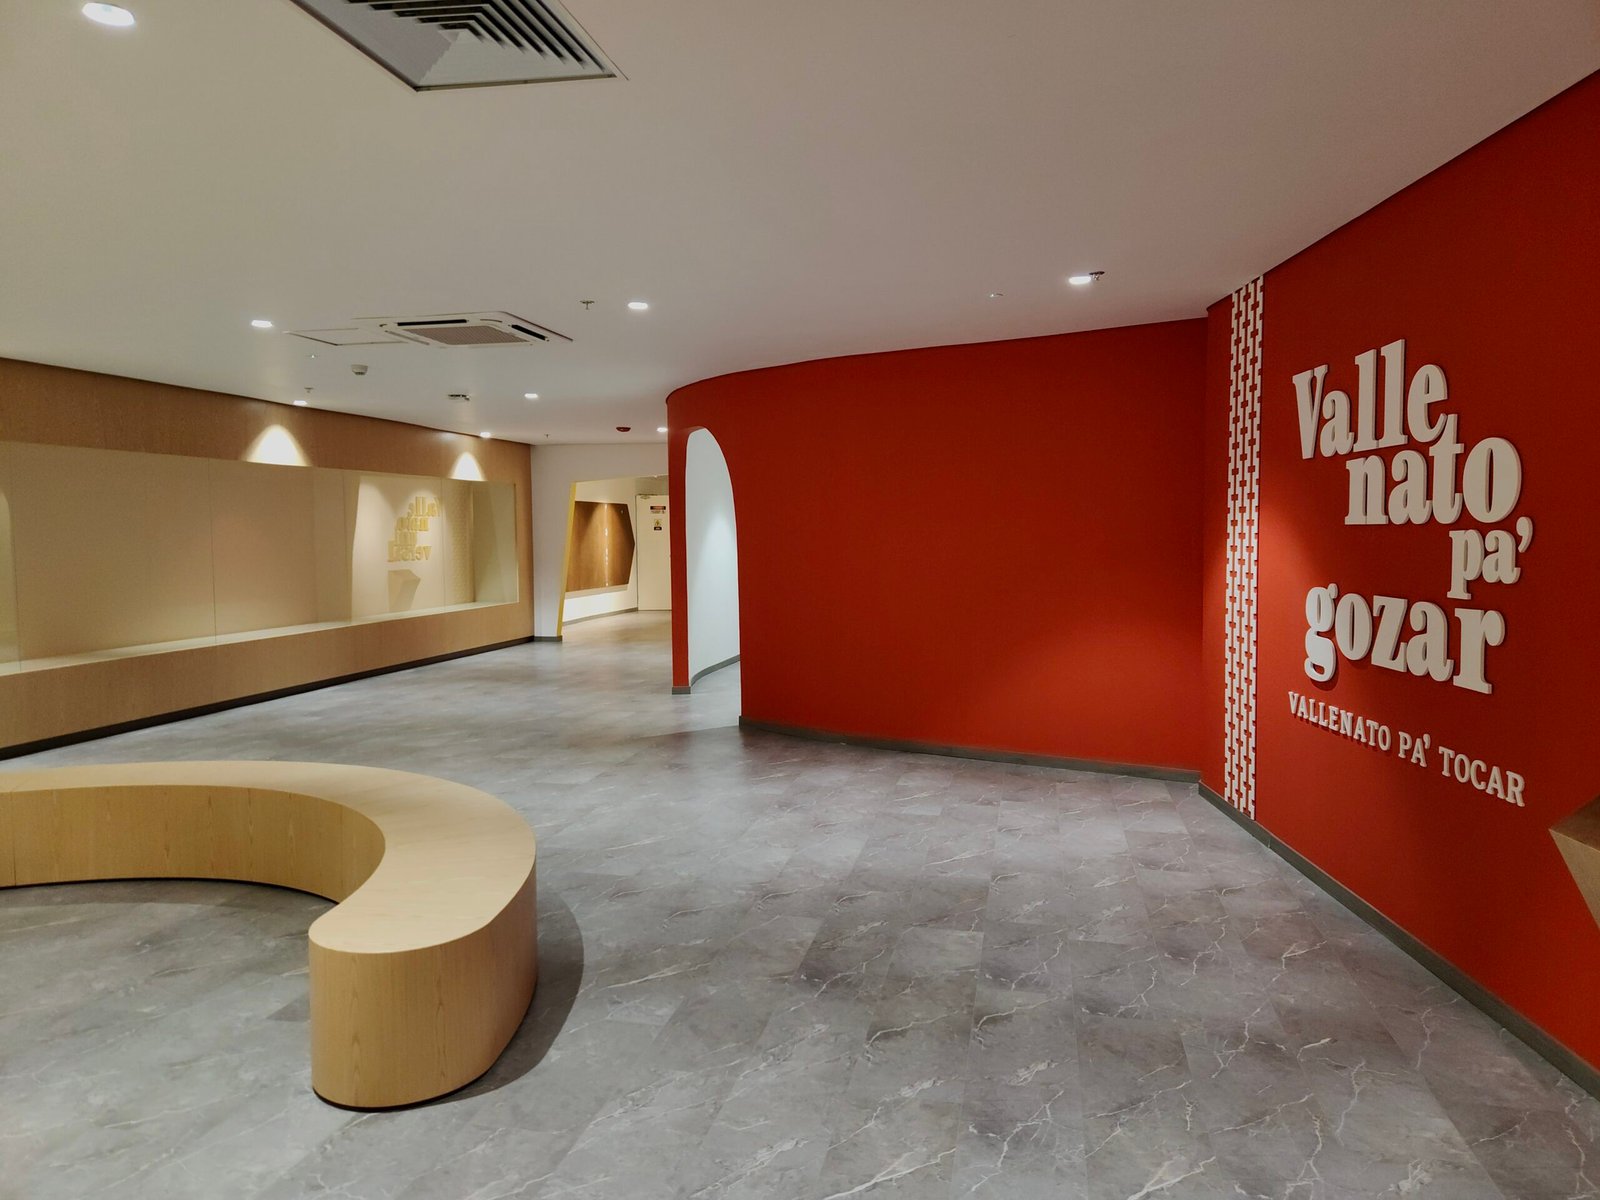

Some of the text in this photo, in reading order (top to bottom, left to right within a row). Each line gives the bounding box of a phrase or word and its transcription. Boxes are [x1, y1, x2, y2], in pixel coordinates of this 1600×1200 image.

[1291, 338, 1448, 460] Valle
[1344, 413, 1522, 526] nato
[1446, 516, 1533, 600] pa'
[1303, 582, 1506, 695] gozar
[1287, 690, 1525, 807] VALLENATO PA' TOCAR
